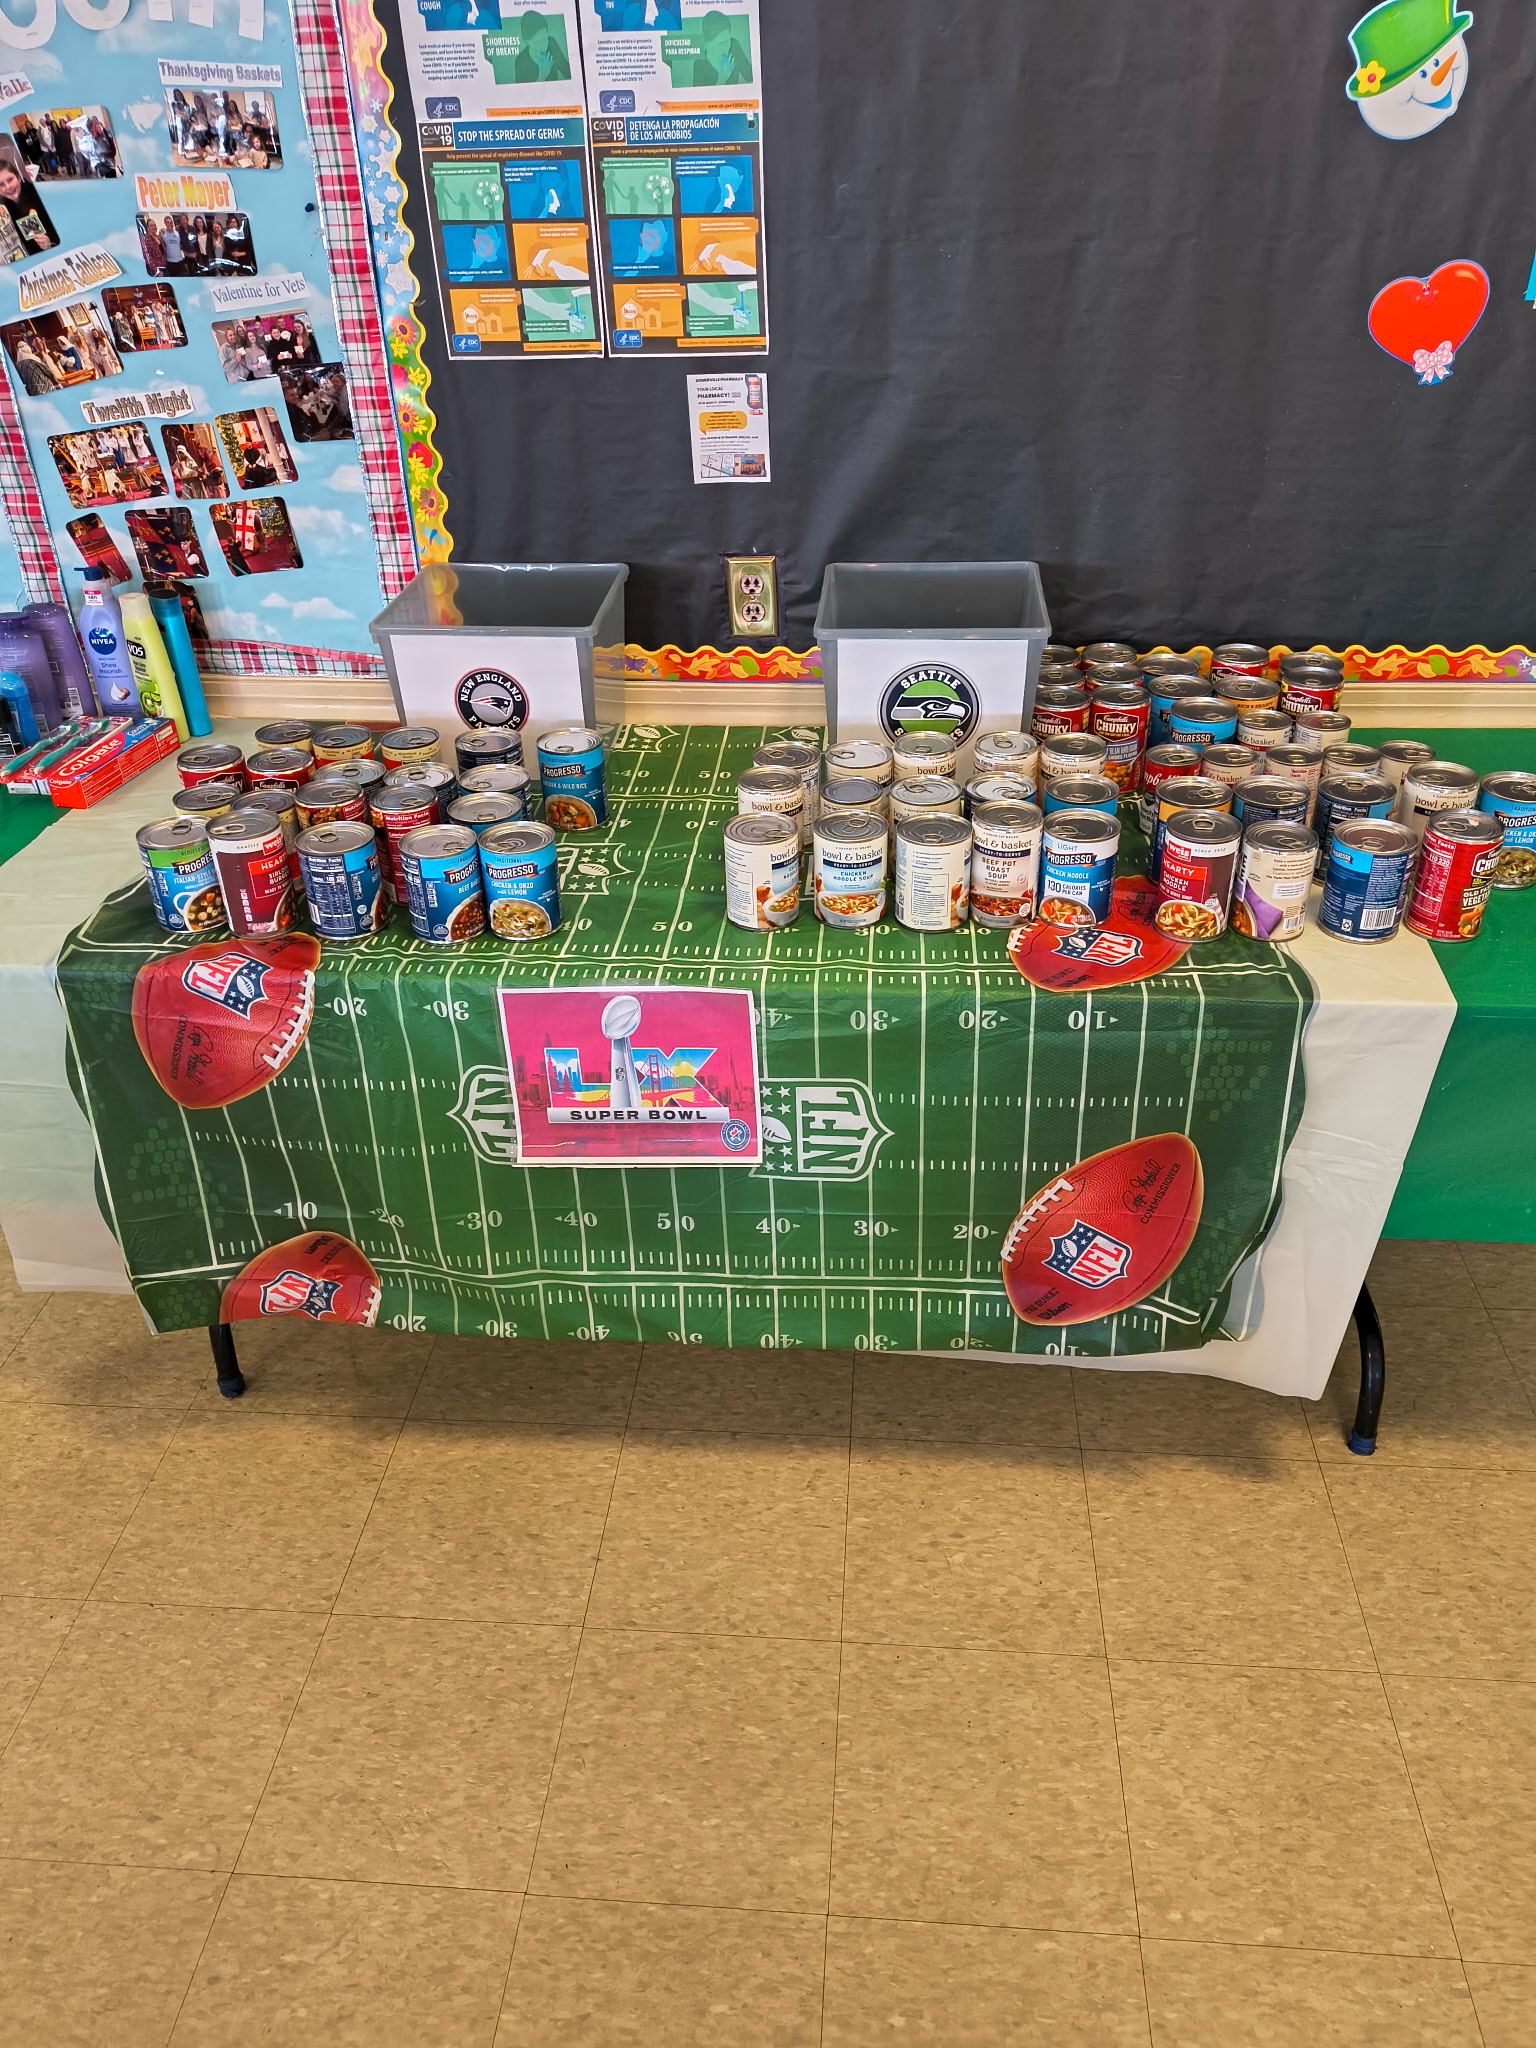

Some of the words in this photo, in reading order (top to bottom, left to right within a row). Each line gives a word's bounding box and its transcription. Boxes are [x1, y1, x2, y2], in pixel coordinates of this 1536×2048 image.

[420, 1, 441, 11] COUGH
[486, 36, 521, 47] SHORTNESS
[486, 48, 495, 57] OF
[496, 47, 520, 56] BREATH
[665, 48, 677, 56] PARA
[158, 61, 235, 83] Thanksgiving
[235, 65, 282, 83] Baskets
[445, 103, 458, 112] CDC
[619, 97, 632, 105] CDC
[629, 120, 661, 131] DETENGA
[661, 119, 671, 130] LA
[671, 117, 720, 130] PROPAGACIÓN
[440, 135, 452, 147] 19
[458, 130, 478, 142] STOP
[478, 130, 495, 142] THE
[495, 129, 526, 141] SPREAD
[526, 128, 537, 140] OF
[537, 127, 565, 140] GERMS
[611, 130, 625, 142] 19
[630, 131, 640, 142] DE
[640, 131, 653, 141] LOS
[654, 130, 692, 141] MICROBIOS
[138, 175, 180, 209] Peter
[181, 177, 230, 211] Mayer
[19, 268, 72, 311] Christmas
[66, 252, 122, 294] Tableau
[212, 283, 263, 308] Valentine
[264, 282, 279, 298] for
[280, 276, 307, 296] Vets
[82, 394, 145, 425] Twelfth
[147, 388, 193, 418] Night
[91, 637, 115, 646] NIVEA
[100, 661, 117, 669] Shea
[99, 668, 123, 676] Nourish
[899, 669, 962, 691] SEATTLE
[460, 678, 476, 703] NEW
[474, 673, 523, 703] ENGLAND
[1280, 698, 1319, 713] CHUNKY
[1031, 720, 1070, 735] CHUNKY
[1095, 719, 1137, 733] CHUNKY
[1171, 732, 1212, 745] PROGRESSO
[1250, 737, 1276, 747] basket
[58, 737, 123, 777] Colgate
[543, 764, 582, 778] PROGRESSO
[697, 769, 733, 780] 50
[917, 766, 938, 776] bowl
[939, 766, 947, 774] &
[1052, 767, 1060, 776] &
[48, 778, 73, 787] Colgate
[576, 782, 588, 790] RICE
[751, 801, 773, 813] bowl
[774, 803, 783, 812] &
[1415, 795, 1438, 809] bowl
[1440, 801, 1450, 811] &
[385, 814, 413, 823] Nutrition
[263, 837, 283, 850] weis
[990, 840, 999, 849] &
[1001, 838, 1034, 851] basket
[1514, 836, 1534, 844] LEMON
[1057, 842, 1079, 853] LIGHT
[1169, 843, 1190, 857] weis
[770, 849, 790, 862] bowl
[821, 847, 842, 860] bowl
[844, 852, 854, 862] &
[855, 847, 884, 861] basket
[1046, 852, 1092, 866] PROGRESSO
[981, 856, 1001, 867] BEEF
[1002, 860, 1017, 868] POT
[1163, 858, 1196, 877] HEARTY
[488, 864, 535, 880] PROGRESSO
[840, 870, 867, 878] CHICKEN
[985, 865, 1011, 874] ROAST
[832, 875, 857, 884] NOODLE
[858, 873, 874, 882] SOUP
[987, 872, 1008, 881] SOUP
[457, 883, 470, 895] BEEF
[519, 881, 535, 890] ORZO
[1047, 879, 1062, 894] 130
[1062, 883, 1087, 893] CALORIES
[507, 889, 528, 897] LEMON
[1463, 890, 1480, 898] OLD
[651, 920, 694, 932] 50
[1088, 932, 1134, 965] NFL
[189, 954, 247, 1001] NFL
[332, 996, 368, 1018] 20
[432, 999, 470, 1021] 30
[849, 1009, 890, 1032] 30
[957, 1009, 999, 1032] 20
[1067, 1009, 1107, 1032] 10
[570, 1109, 641, 1121] SUPER
[648, 1109, 708, 1121] BOWL
[800, 1090, 870, 1171] NFL
[1139, 1162, 1182, 1225] COMMISSIONER
[282, 1201, 319, 1221] 10
[377, 1208, 406, 1229] 20
[466, 1210, 504, 1231] 30
[562, 1210, 599, 1229] 40
[656, 1212, 696, 1232] 50
[755, 1216, 792, 1235] 40
[852, 1220, 890, 1238] 30
[952, 1223, 990, 1240] 20
[1070, 1243, 1126, 1285] NFL
[267, 1273, 311, 1313] NFL
[392, 1313, 427, 1332] 20
[484, 1319, 519, 1339] 30
[575, 1324, 612, 1341] 40
[759, 1332, 798, 1349] 40
[853, 1333, 889, 1351] 30
[1044, 1342, 1079, 1356] 10
